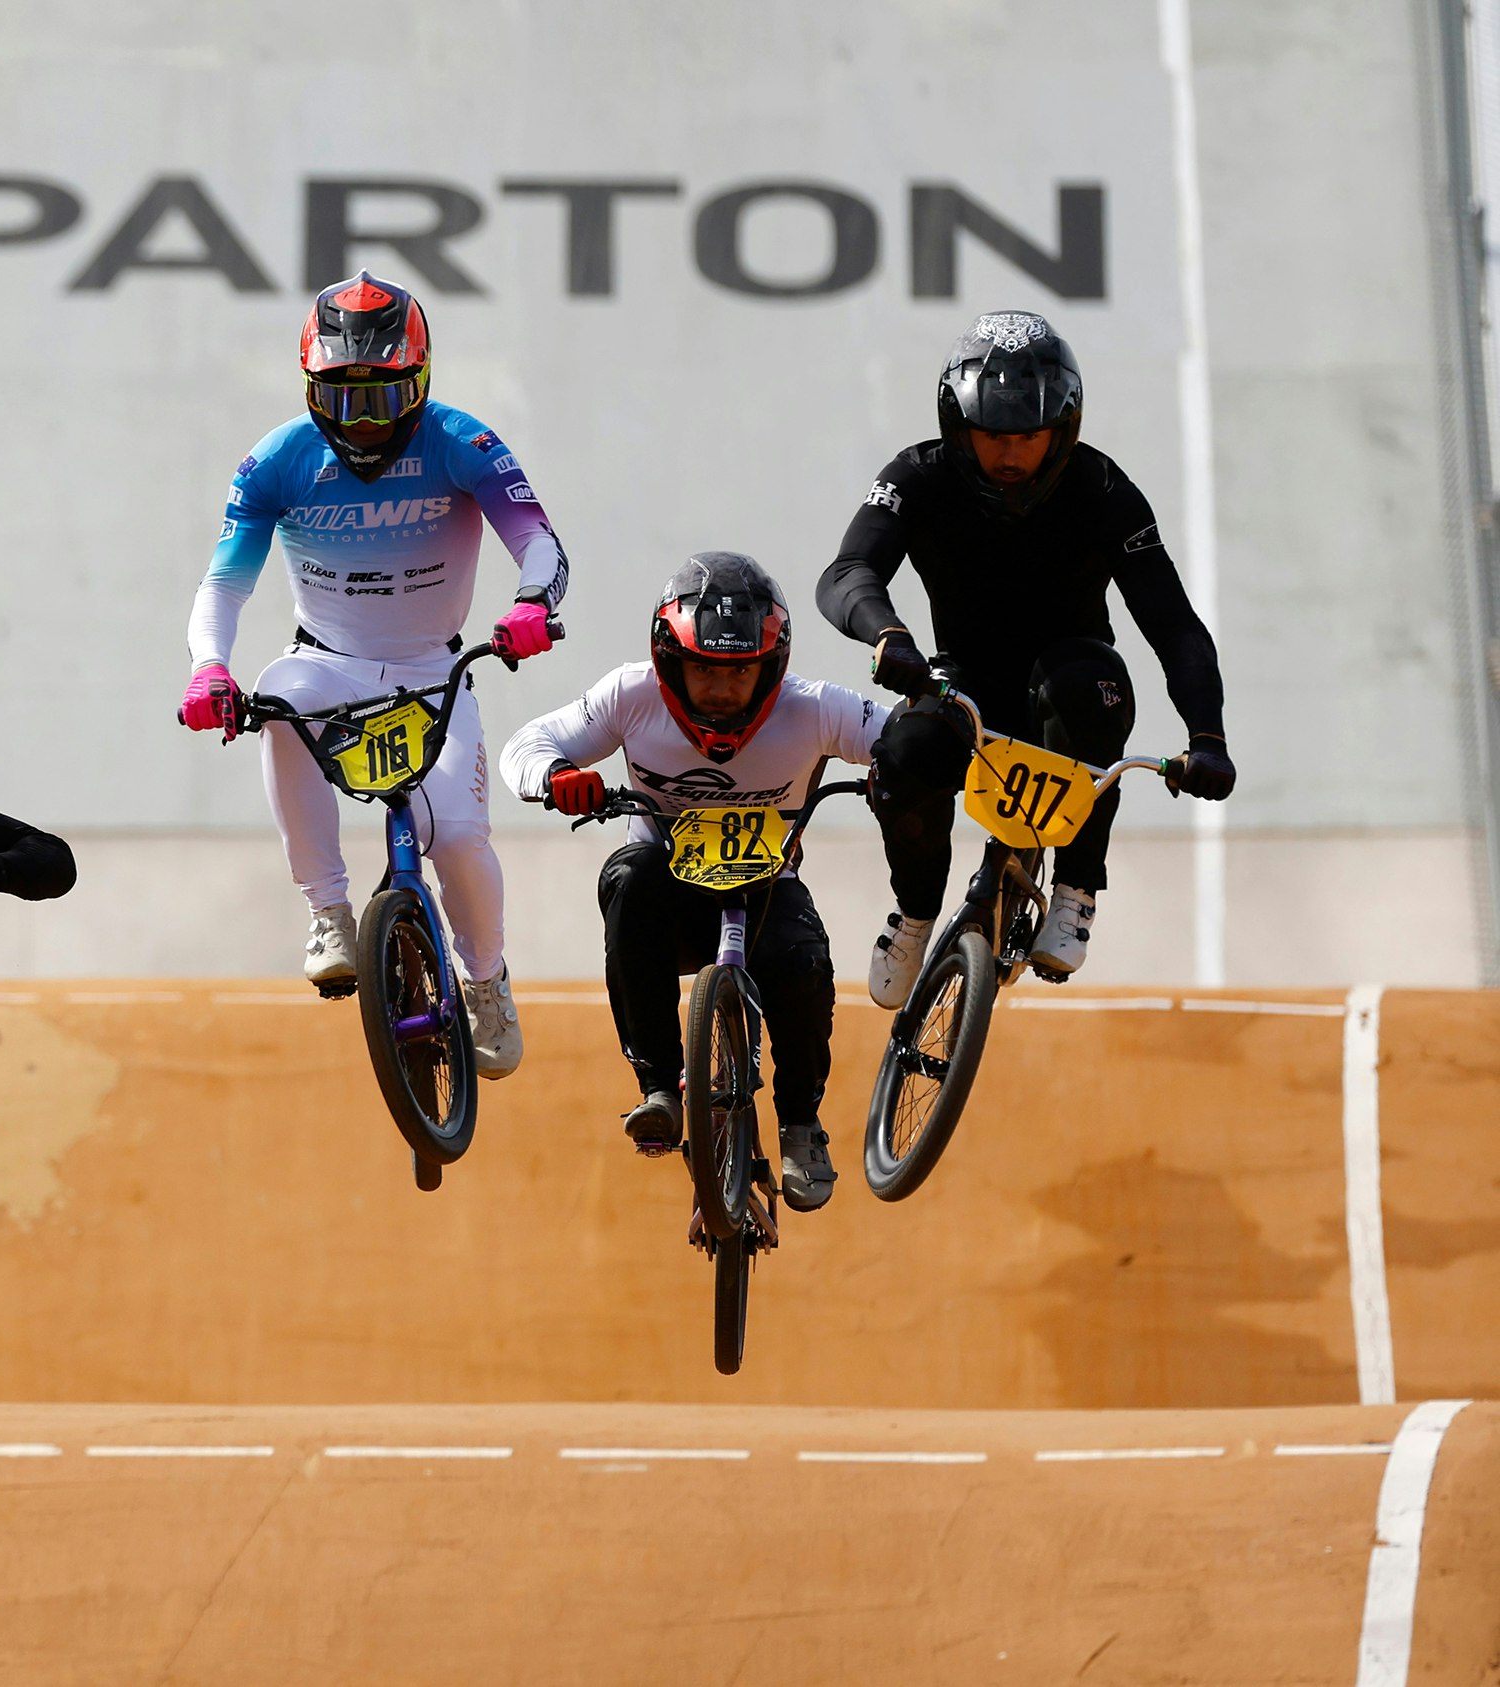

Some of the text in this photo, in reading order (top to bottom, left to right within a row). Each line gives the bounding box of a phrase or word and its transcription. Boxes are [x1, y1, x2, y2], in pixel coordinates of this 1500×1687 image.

[284, 497, 452, 530] WIAWIS
[390, 524, 438, 539] TEAM
[310, 565, 337, 579] LEAD
[718, 639, 748, 648] Racing
[350, 699, 397, 720] TANGENT
[365, 723, 411, 784] 116
[996, 762, 1072, 832] 917
[720, 811, 765, 861] 82
